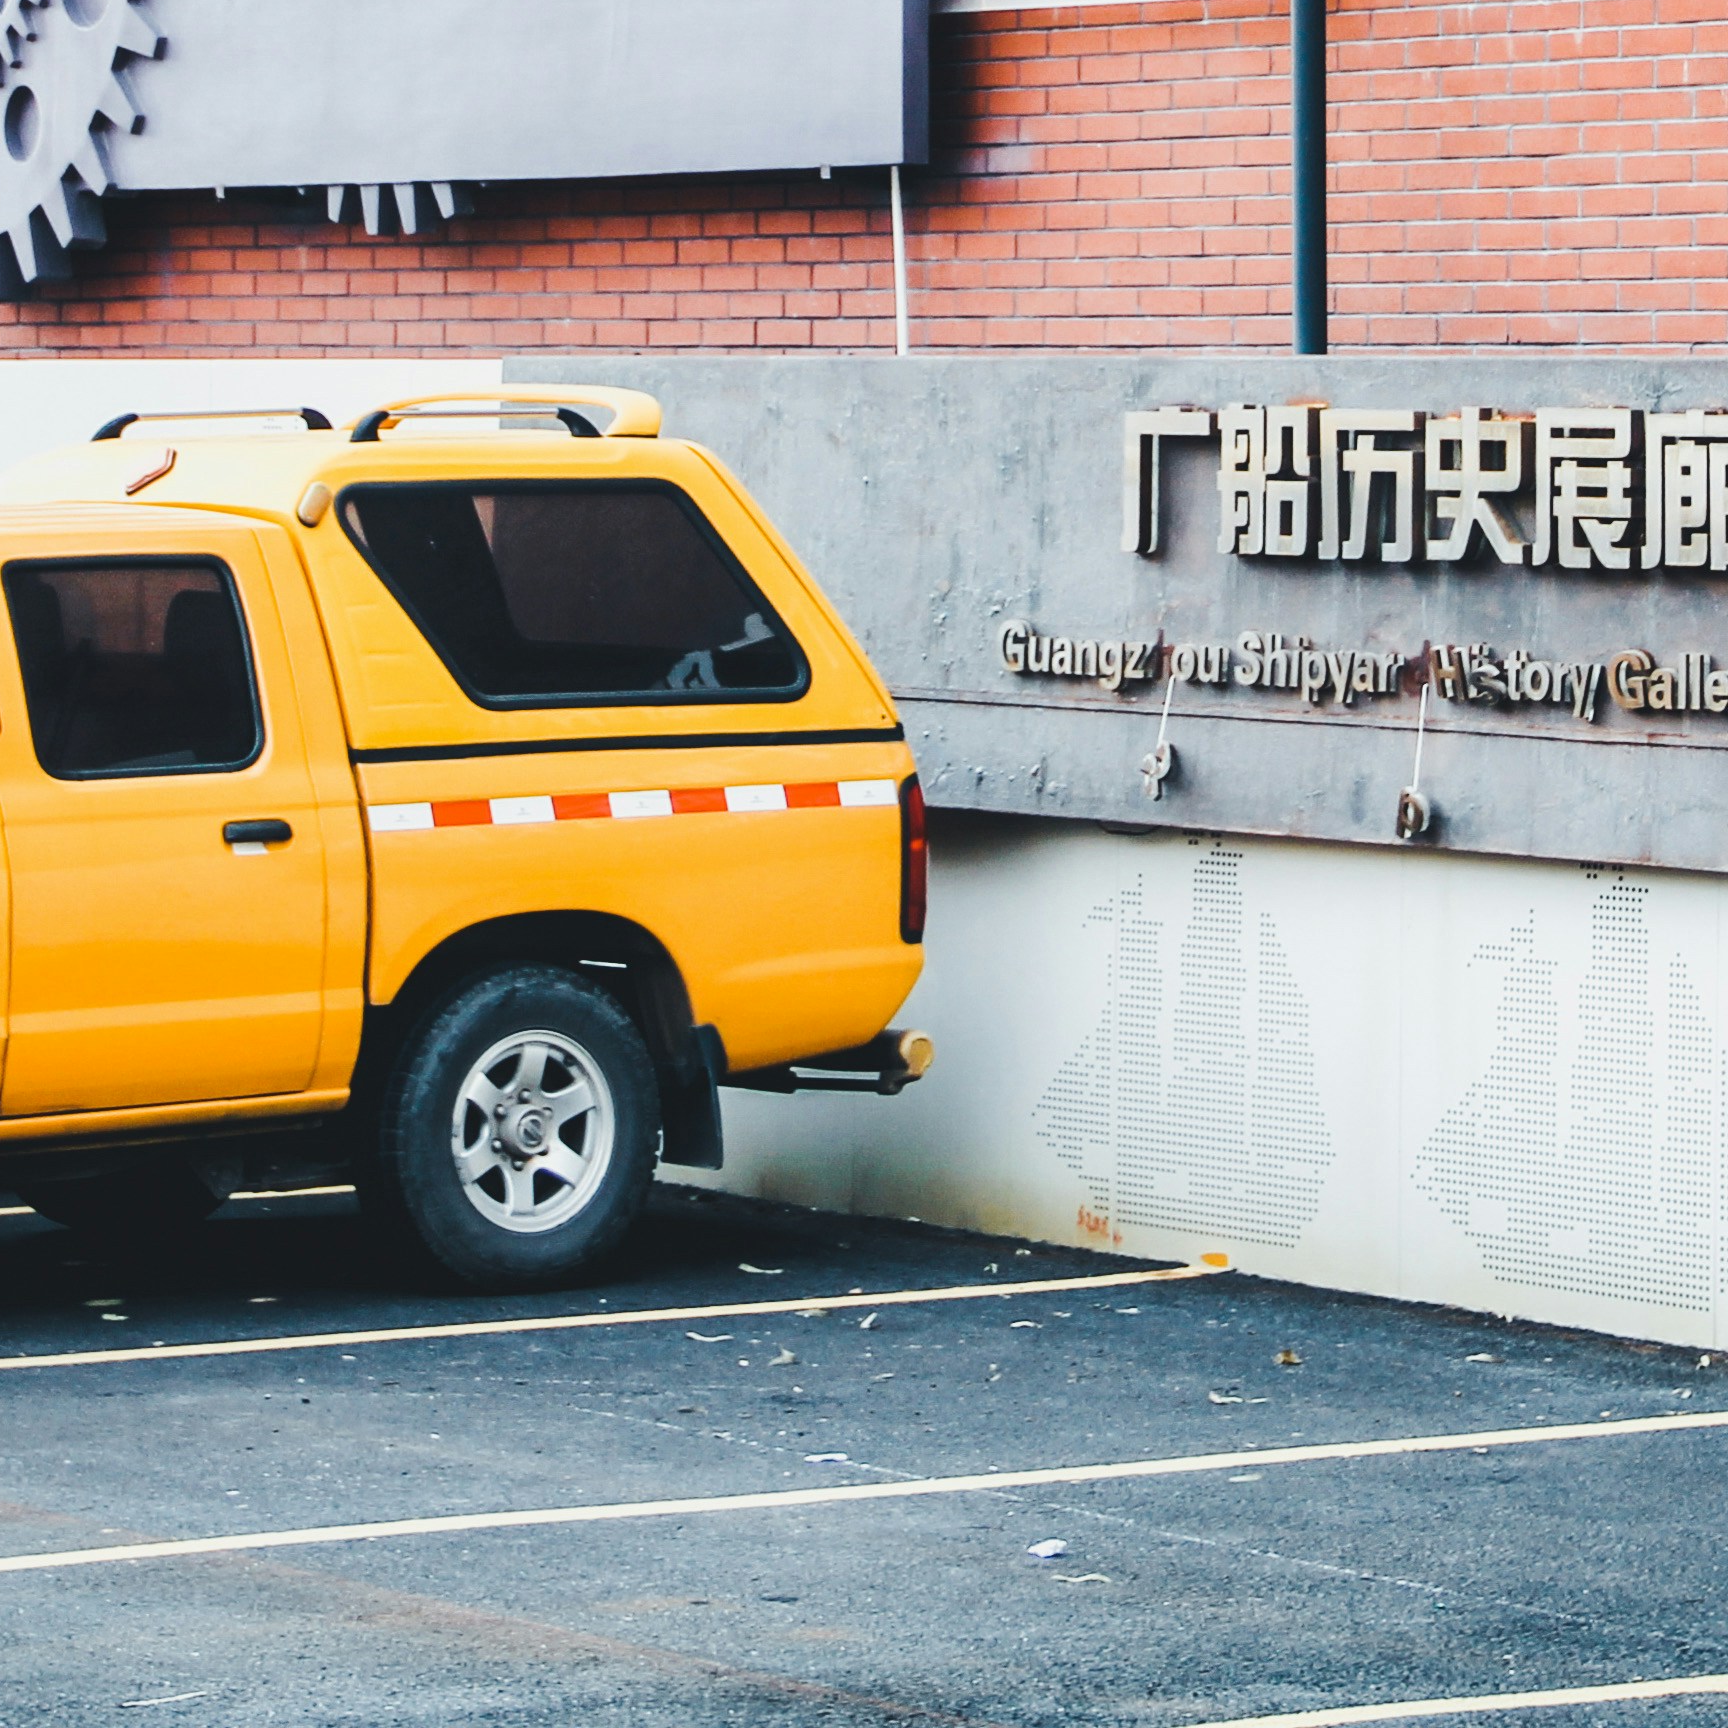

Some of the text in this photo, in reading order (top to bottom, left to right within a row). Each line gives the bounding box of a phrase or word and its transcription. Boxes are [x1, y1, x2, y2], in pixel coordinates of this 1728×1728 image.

[996, 618, 1230, 692] Guangzou
[1234, 630, 1430, 704] Shipyar
[1429, 642, 1603, 722] History
